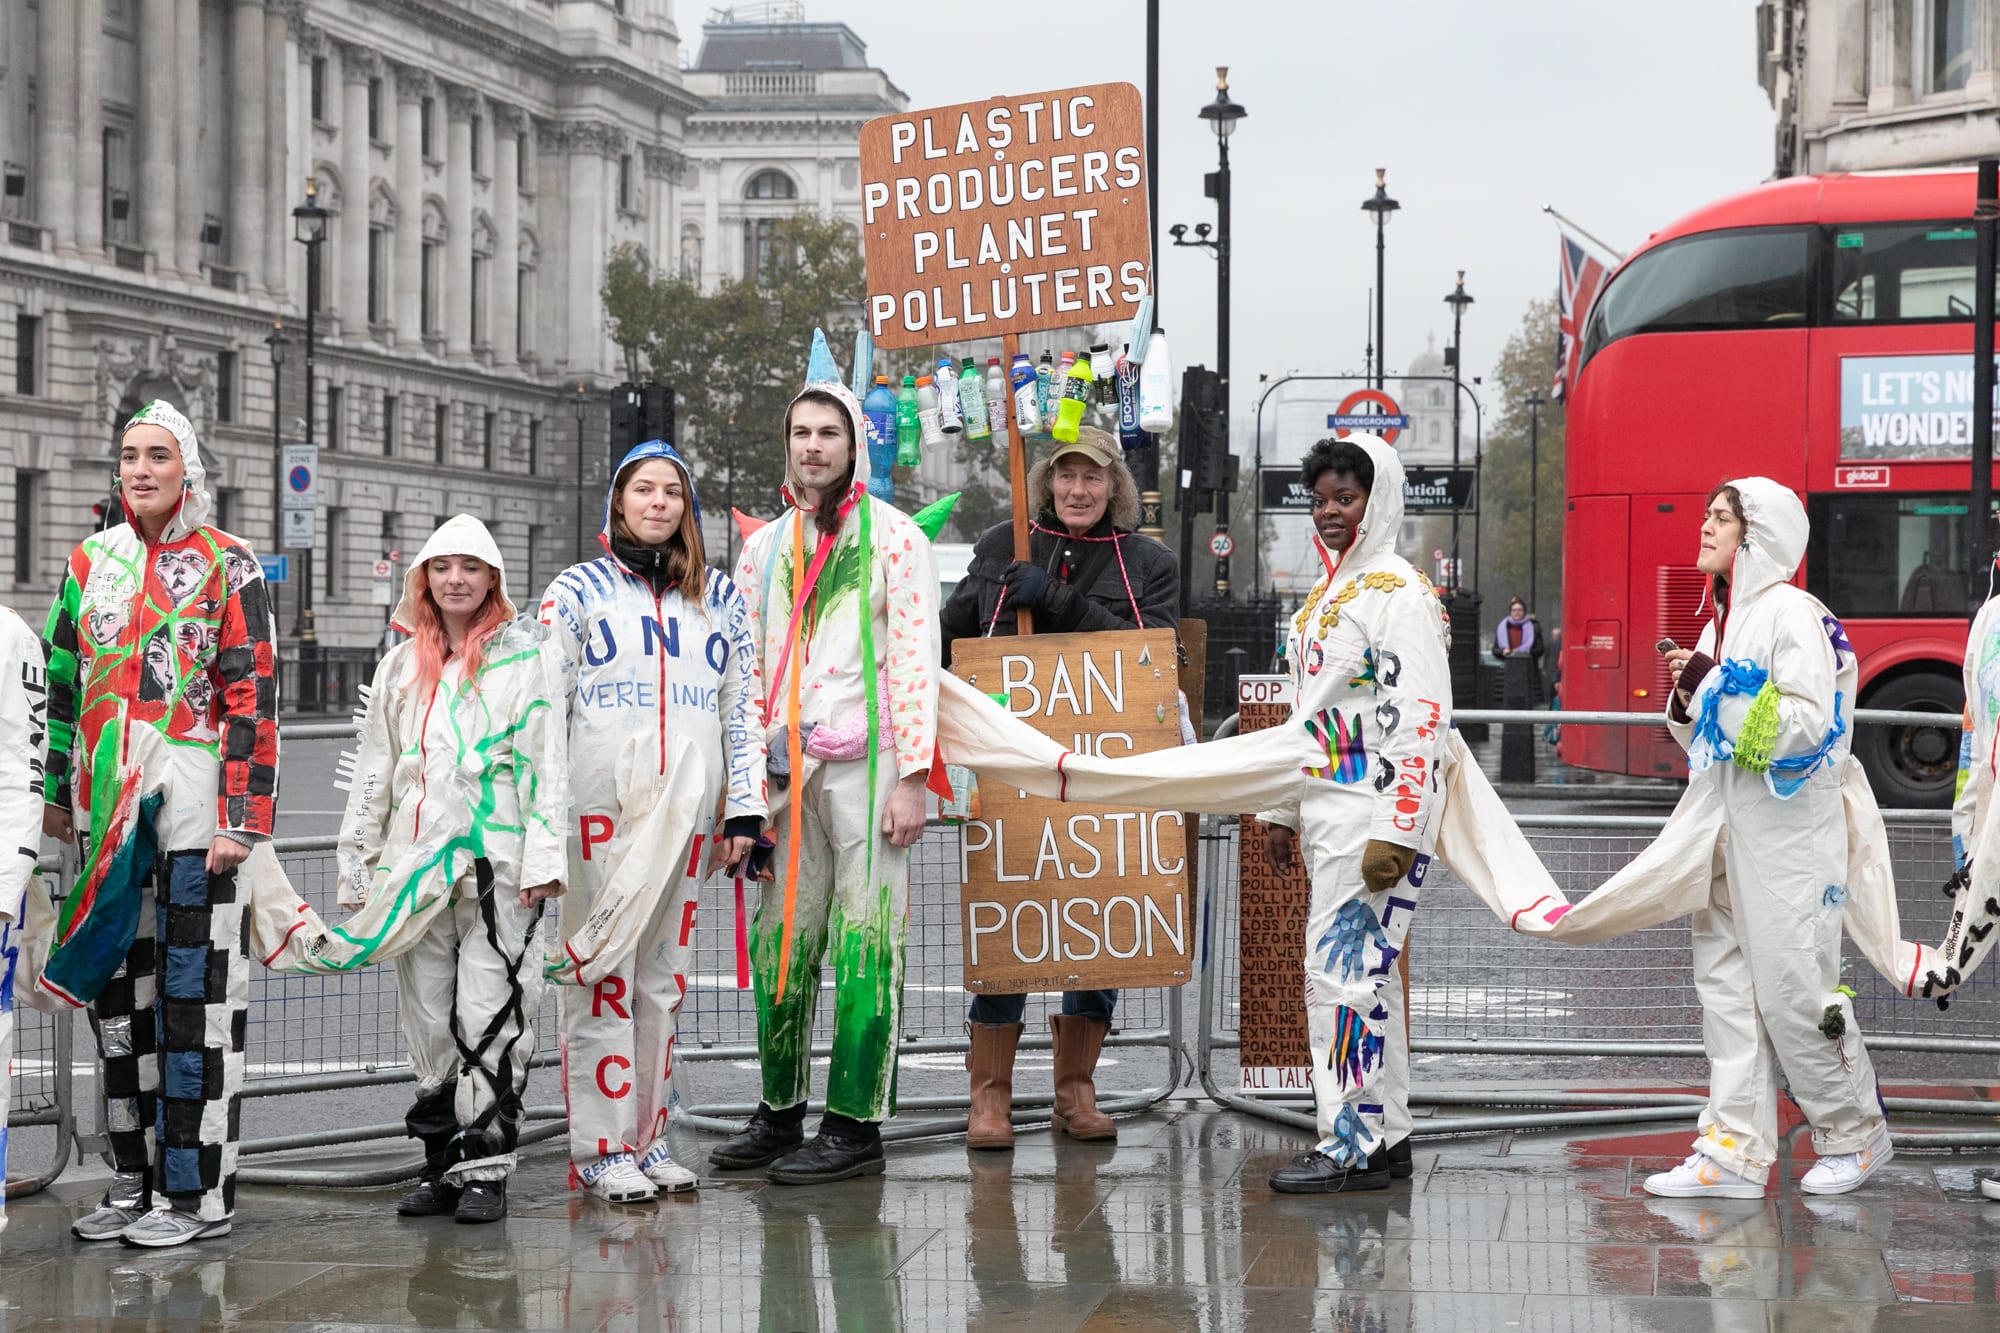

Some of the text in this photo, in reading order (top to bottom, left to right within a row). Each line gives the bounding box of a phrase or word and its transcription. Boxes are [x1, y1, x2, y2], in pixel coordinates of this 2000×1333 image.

[890, 95, 1096, 164] PLASTIC
[863, 146, 1142, 224] PRODUCERS
[912, 207, 1099, 274] PLANET
[871, 260, 1147, 337] POLLUTERS
[1862, 370, 1940, 406] LET'S
[1334, 417, 1402, 426] UNDERGROUND
[1846, 470, 1879, 485] global
[1404, 484, 1446, 496] ation
[1282, 496, 1312, 505] Public
[1213, 540, 1229, 550] 20
[1001, 650, 1124, 718] BAN
[1240, 682, 1282, 702] COP
[960, 810, 1185, 884] PLASTIC
[968, 893, 1186, 966] POISON
[1241, 919, 1305, 931] LOSS OF
[1241, 946, 1304, 958] VERY WET
[1241, 986, 1302, 998] PLASTIC
[1241, 1000, 1273, 1012] SOIL
[1240, 1013, 1297, 1025] MELTING
[1240, 1026, 1305, 1038] EXTREME
[1240, 1054, 1299, 1066] APATHY
[1243, 1067, 1314, 1088] ALL TALK
